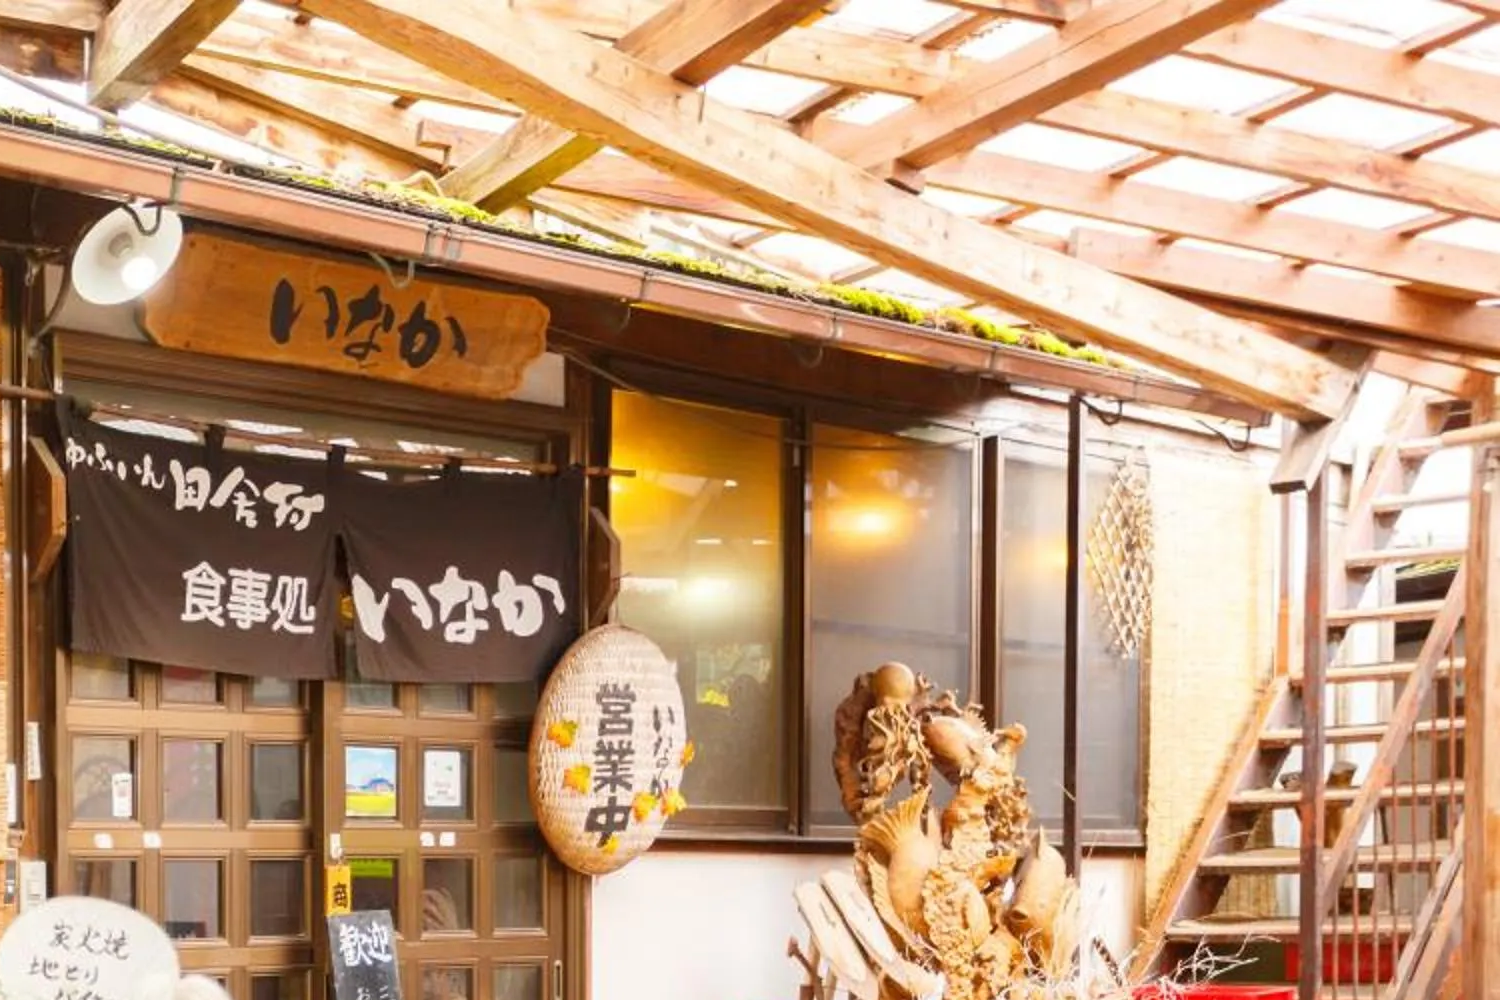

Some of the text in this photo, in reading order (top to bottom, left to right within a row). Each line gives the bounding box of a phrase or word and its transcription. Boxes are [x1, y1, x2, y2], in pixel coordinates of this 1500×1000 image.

[269, 277, 468, 369] いなか
[180, 562, 316, 634] 食事処
[351, 566, 566, 644] いなか
[584, 683, 638, 848] 営業中
